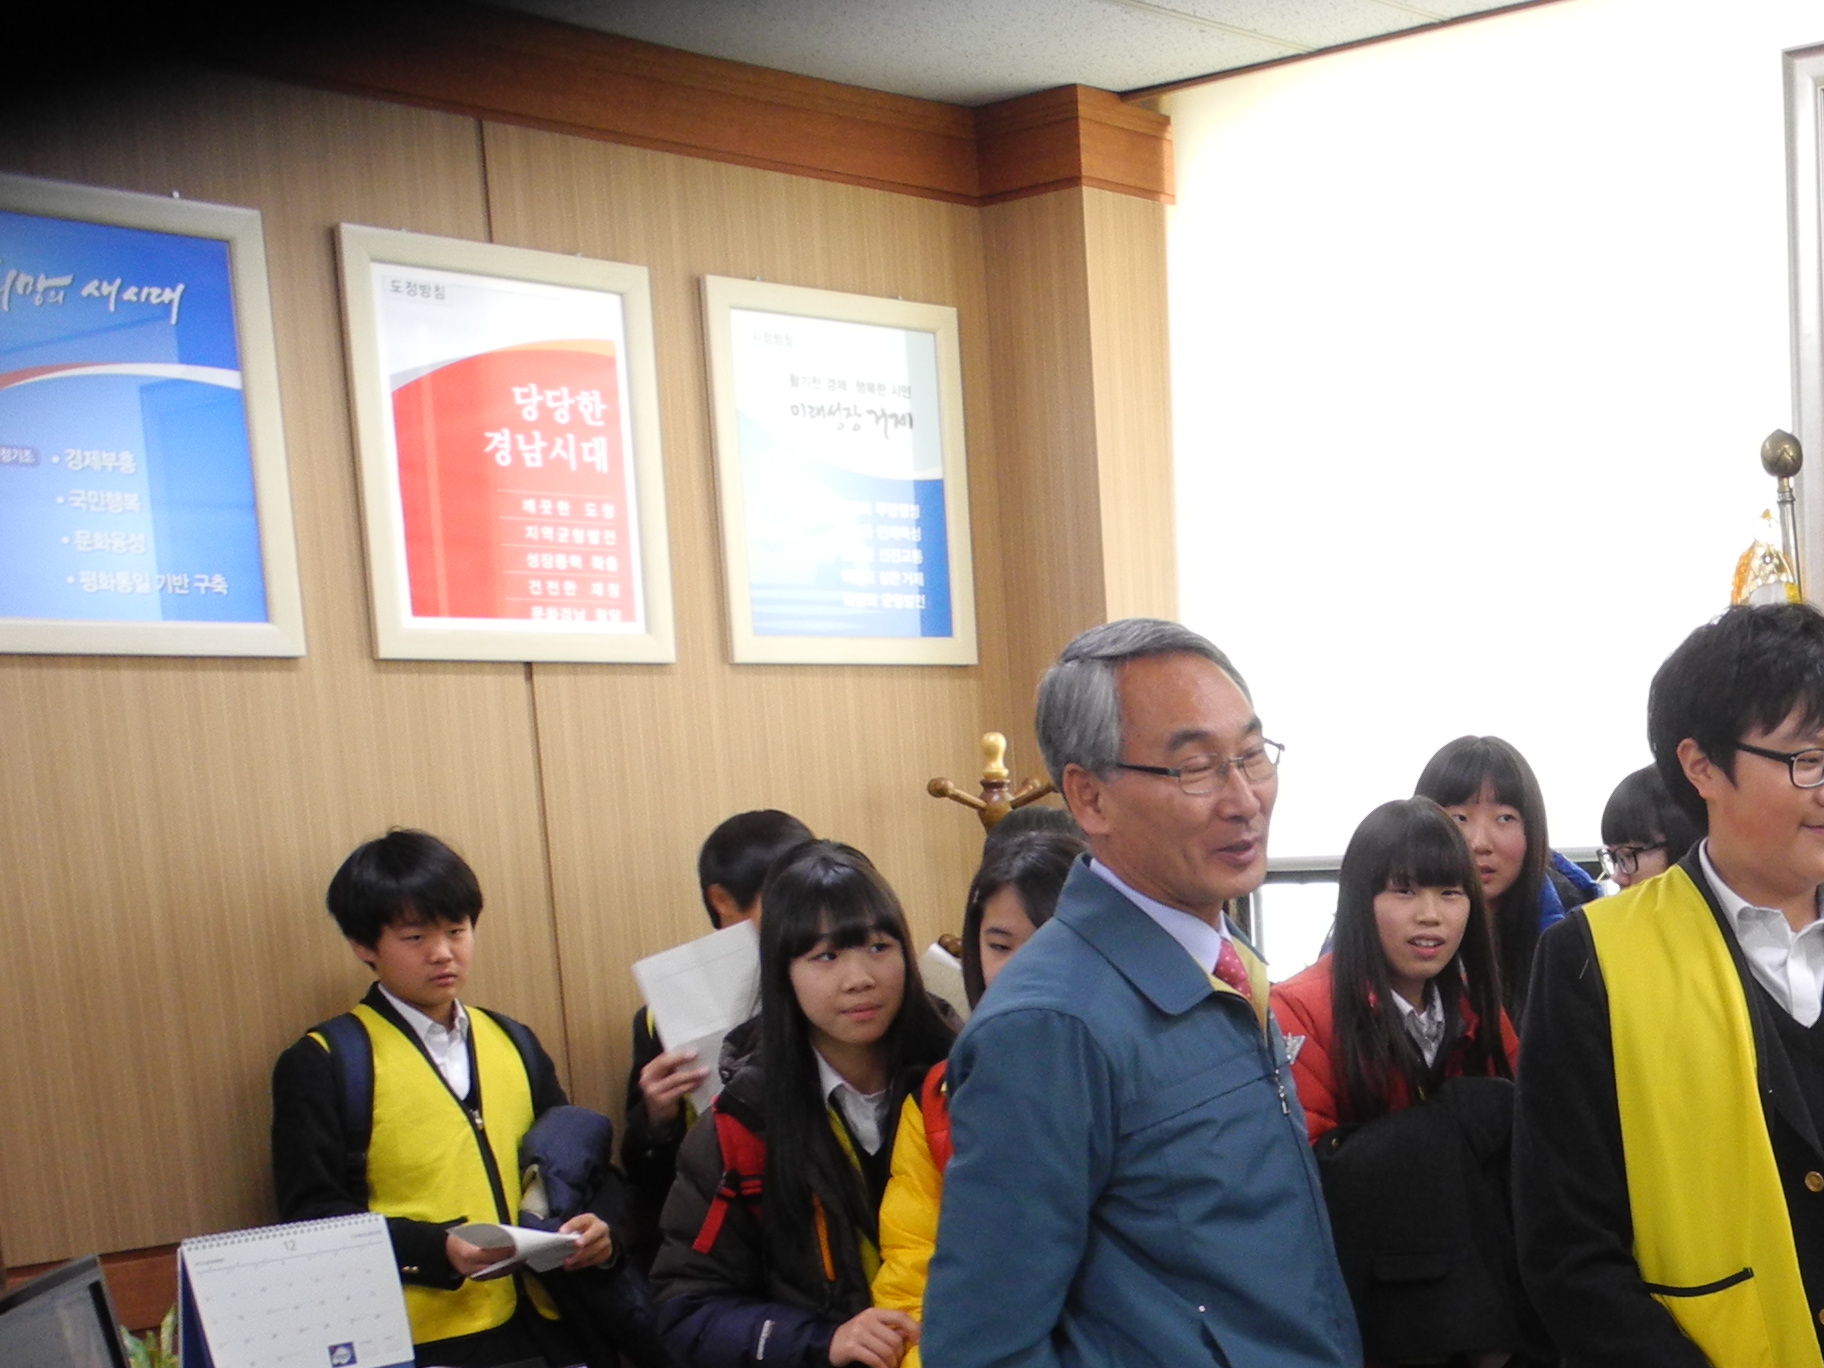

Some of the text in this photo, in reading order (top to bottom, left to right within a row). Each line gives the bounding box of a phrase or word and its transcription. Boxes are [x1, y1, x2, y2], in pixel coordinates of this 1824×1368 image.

[0, 269, 74, 312] 망의
[390, 279, 446, 300] 도정방침
[789, 373, 912, 400] 활기찬 경제 행복한 시민
[512, 383, 608, 427] 당당한
[65, 447, 138, 475] 경제부흥
[484, 427, 610, 474] 경남시대
[69, 488, 141, 513] 국민행복
[585, 502, 615, 519] 도정
[75, 530, 147, 555] 문화융성
[79, 570, 230, 596] 평화통일 기반 구축
[528, 579, 577, 597] 건전한
[283, 1240, 298, 1252] 12
